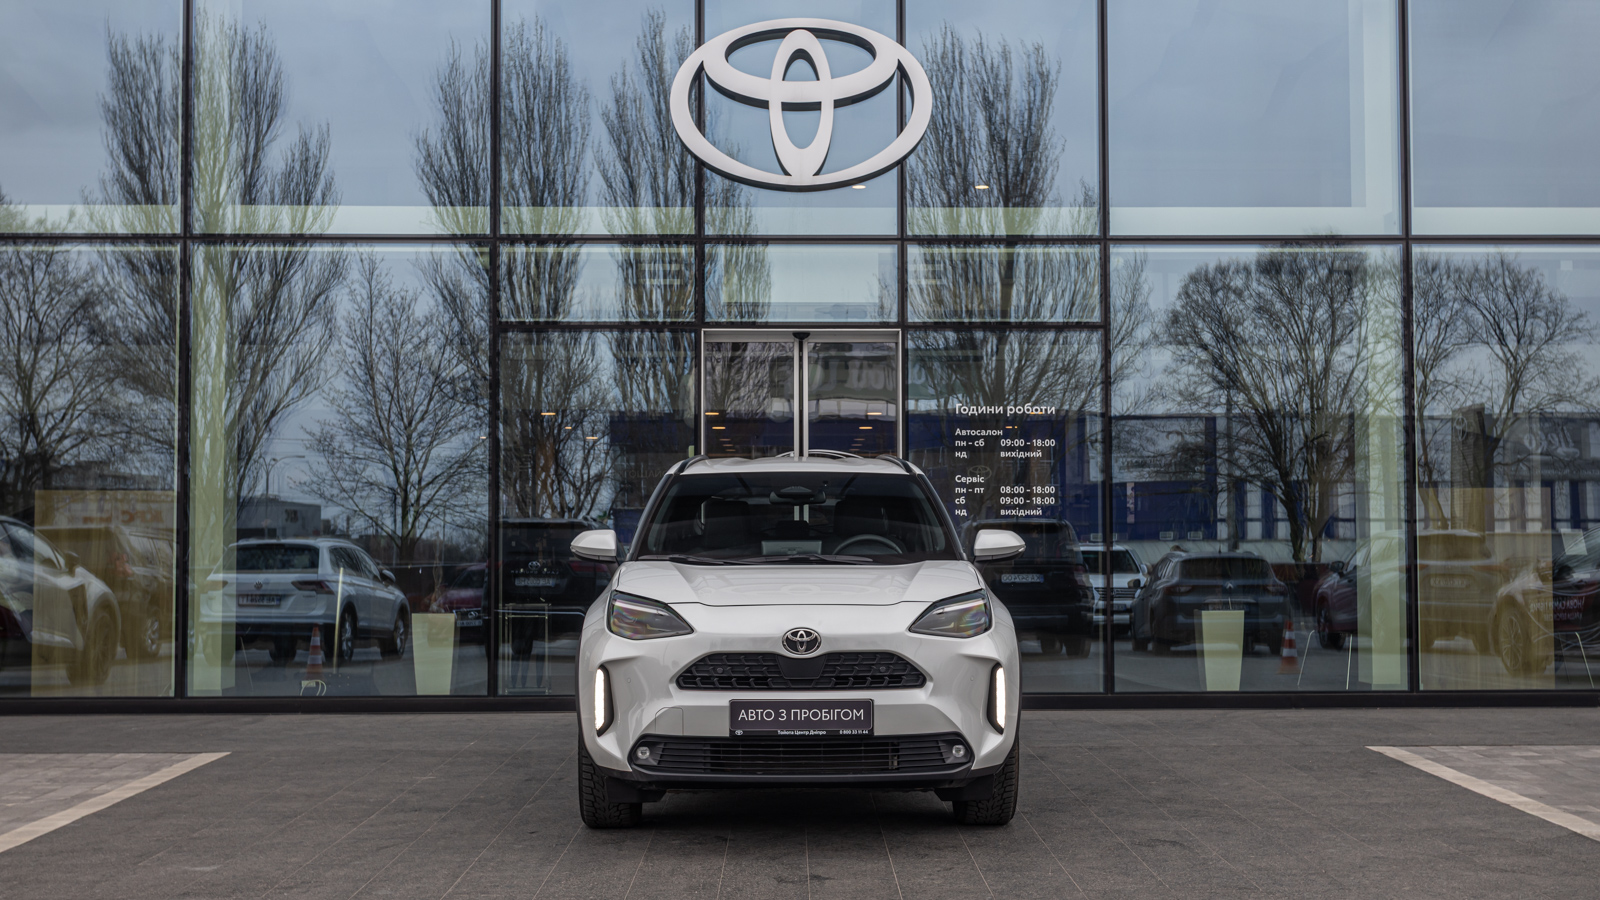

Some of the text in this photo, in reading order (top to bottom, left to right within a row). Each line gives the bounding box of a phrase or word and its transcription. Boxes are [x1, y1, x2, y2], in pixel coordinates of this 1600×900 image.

[956, 403, 1056, 416] Години роботи
[1000, 450, 1042, 458] вихідний
[955, 475, 984, 484] Сервіс
[1000, 508, 1042, 516] вихідний
[738, 709, 864, 721] АВТО З ПРОБІГОМ
